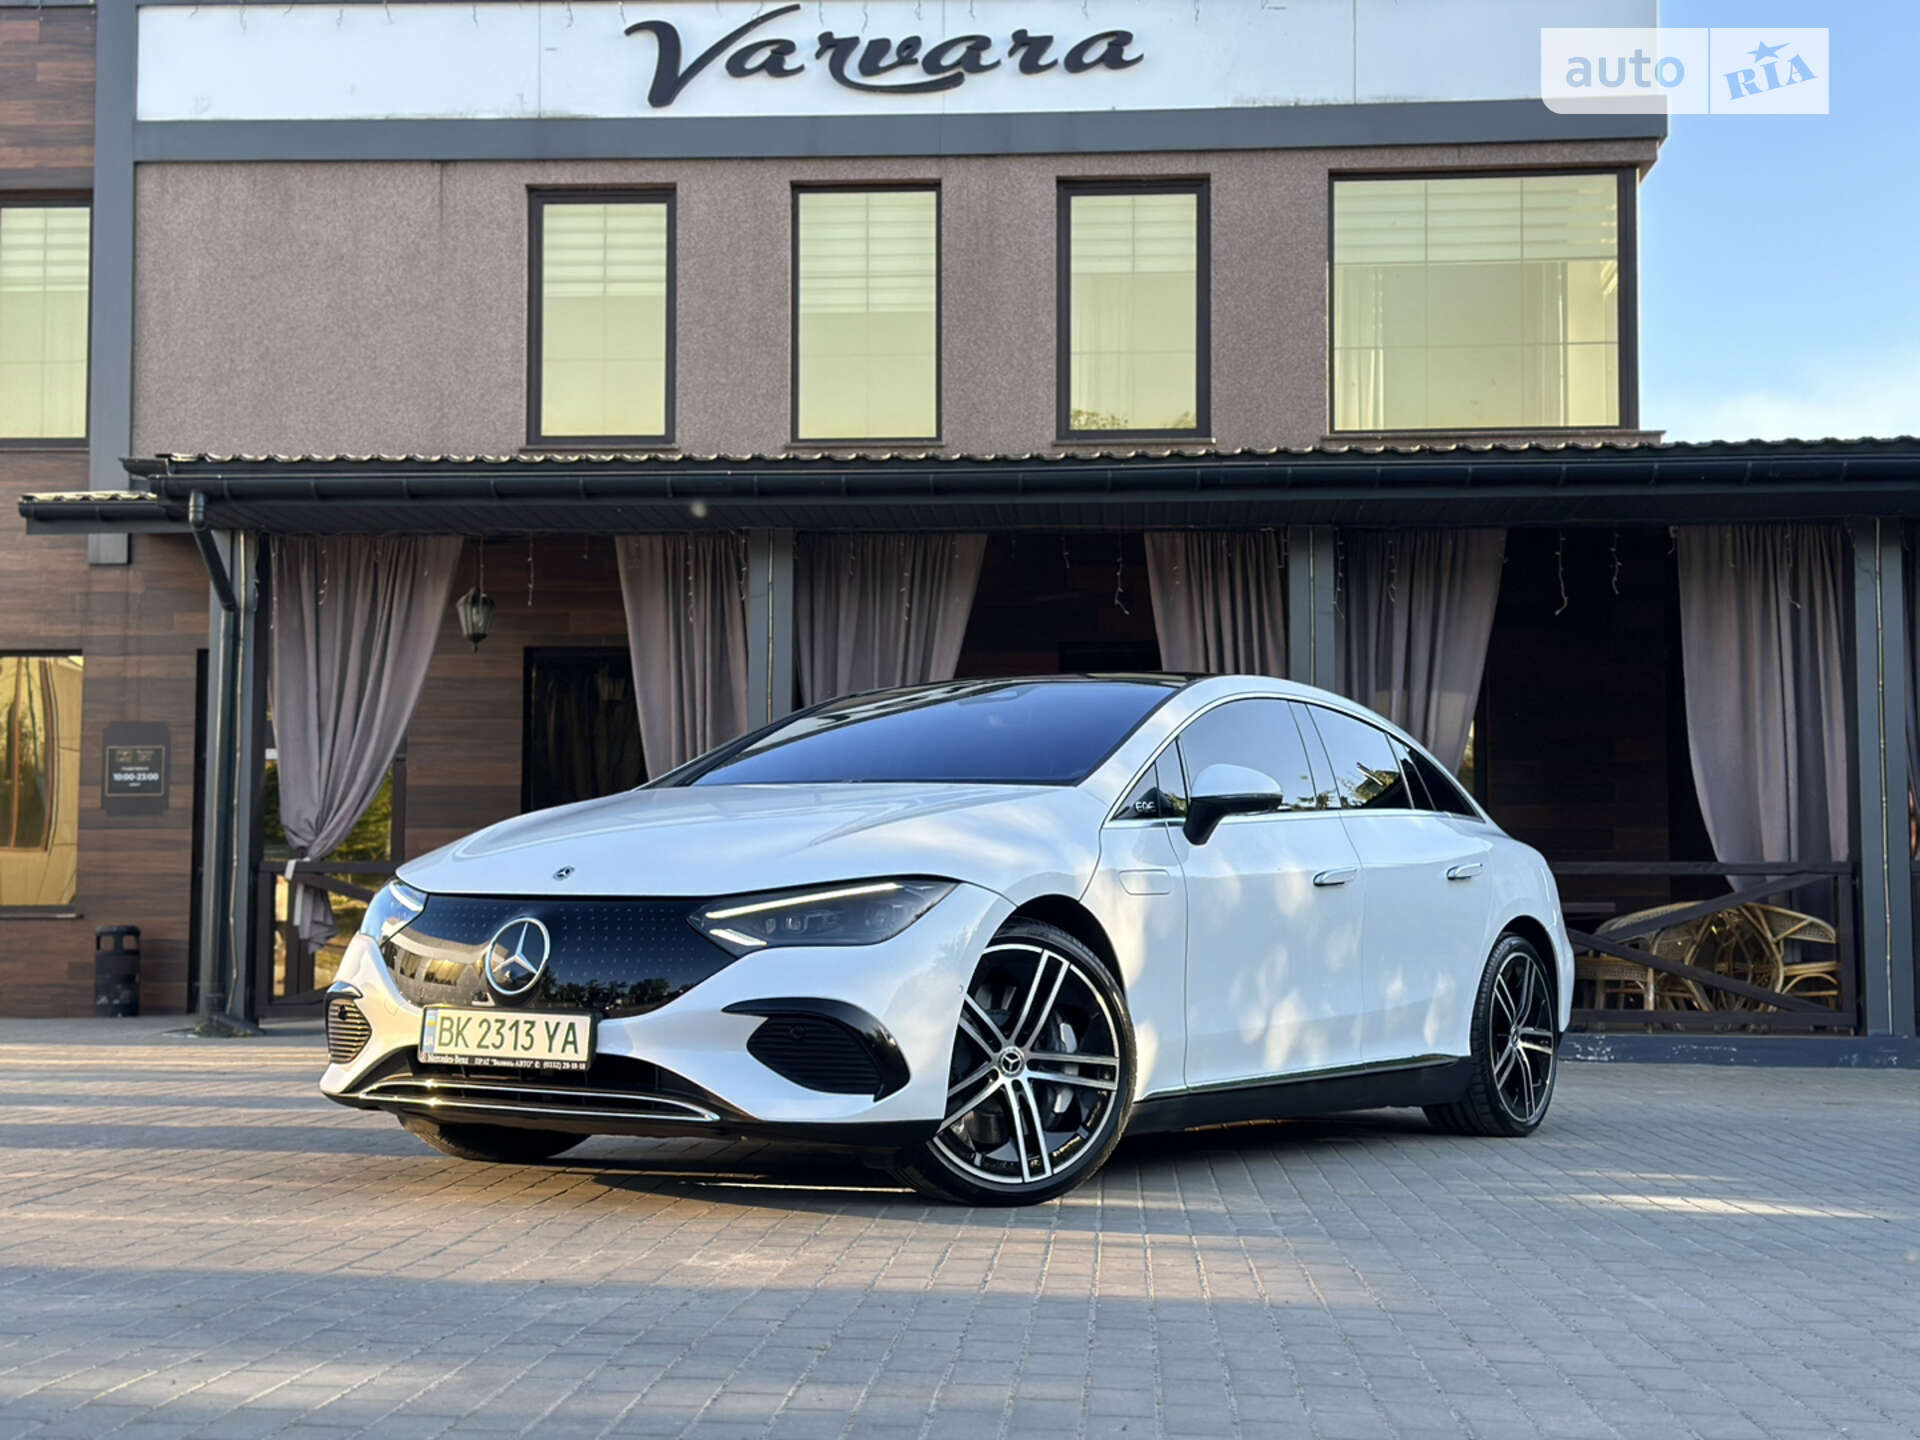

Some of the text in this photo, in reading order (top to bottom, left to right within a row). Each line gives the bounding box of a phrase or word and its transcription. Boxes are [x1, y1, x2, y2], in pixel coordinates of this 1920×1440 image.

[624, 3, 1145, 108] Varvara
[438, 1016, 472, 1048] BK
[476, 1018, 536, 1051] 2313
[544, 1020, 579, 1054] YA
